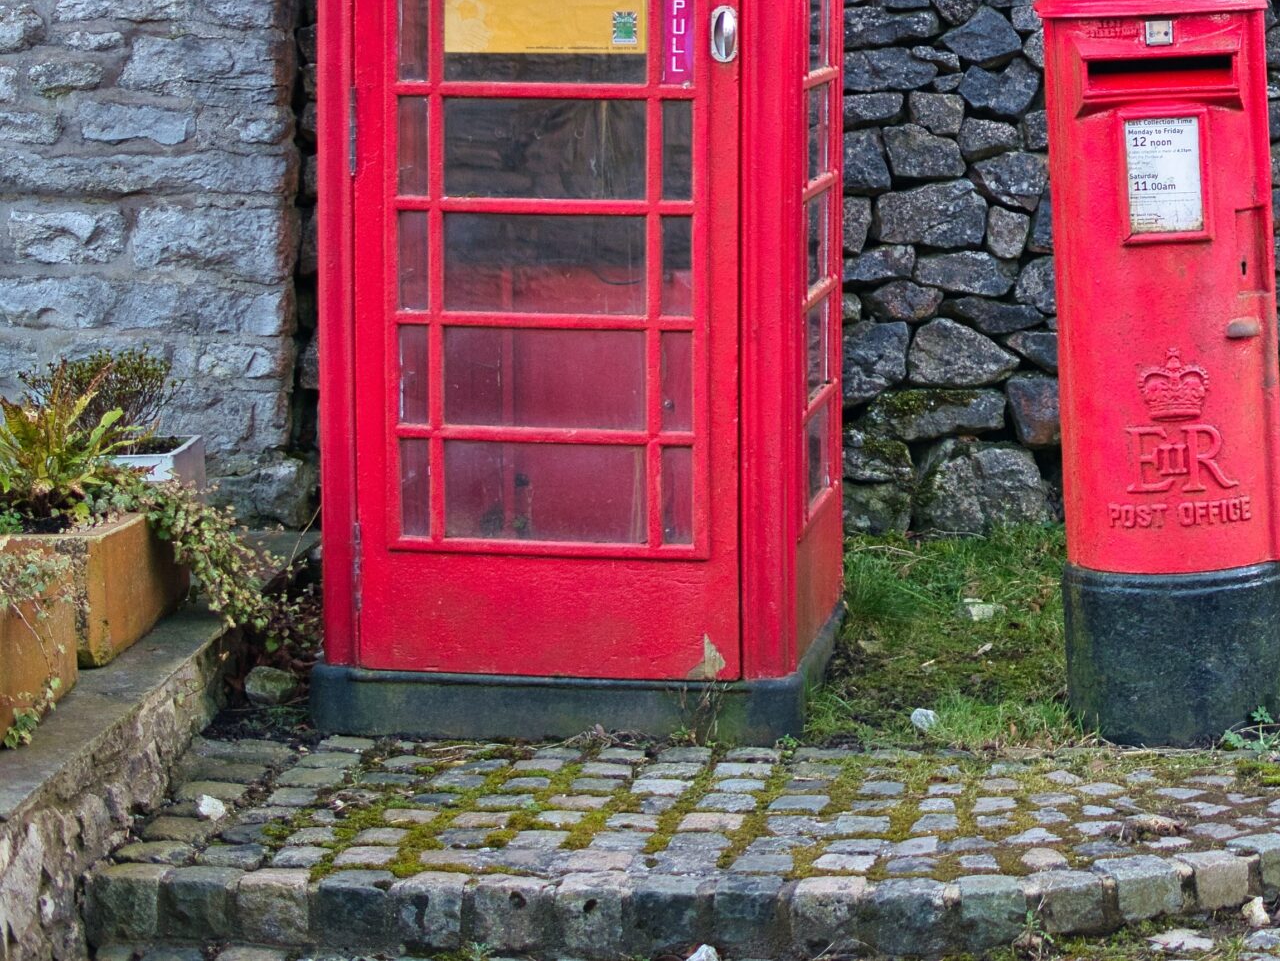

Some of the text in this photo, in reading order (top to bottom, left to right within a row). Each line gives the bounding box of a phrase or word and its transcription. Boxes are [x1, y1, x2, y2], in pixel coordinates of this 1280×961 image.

[671, 0, 686, 72] PULL
[1132, 136, 1172, 148] 12 noon
[1134, 180, 1176, 192] 11.00am
[1107, 496, 1252, 529] POST OFFICE
